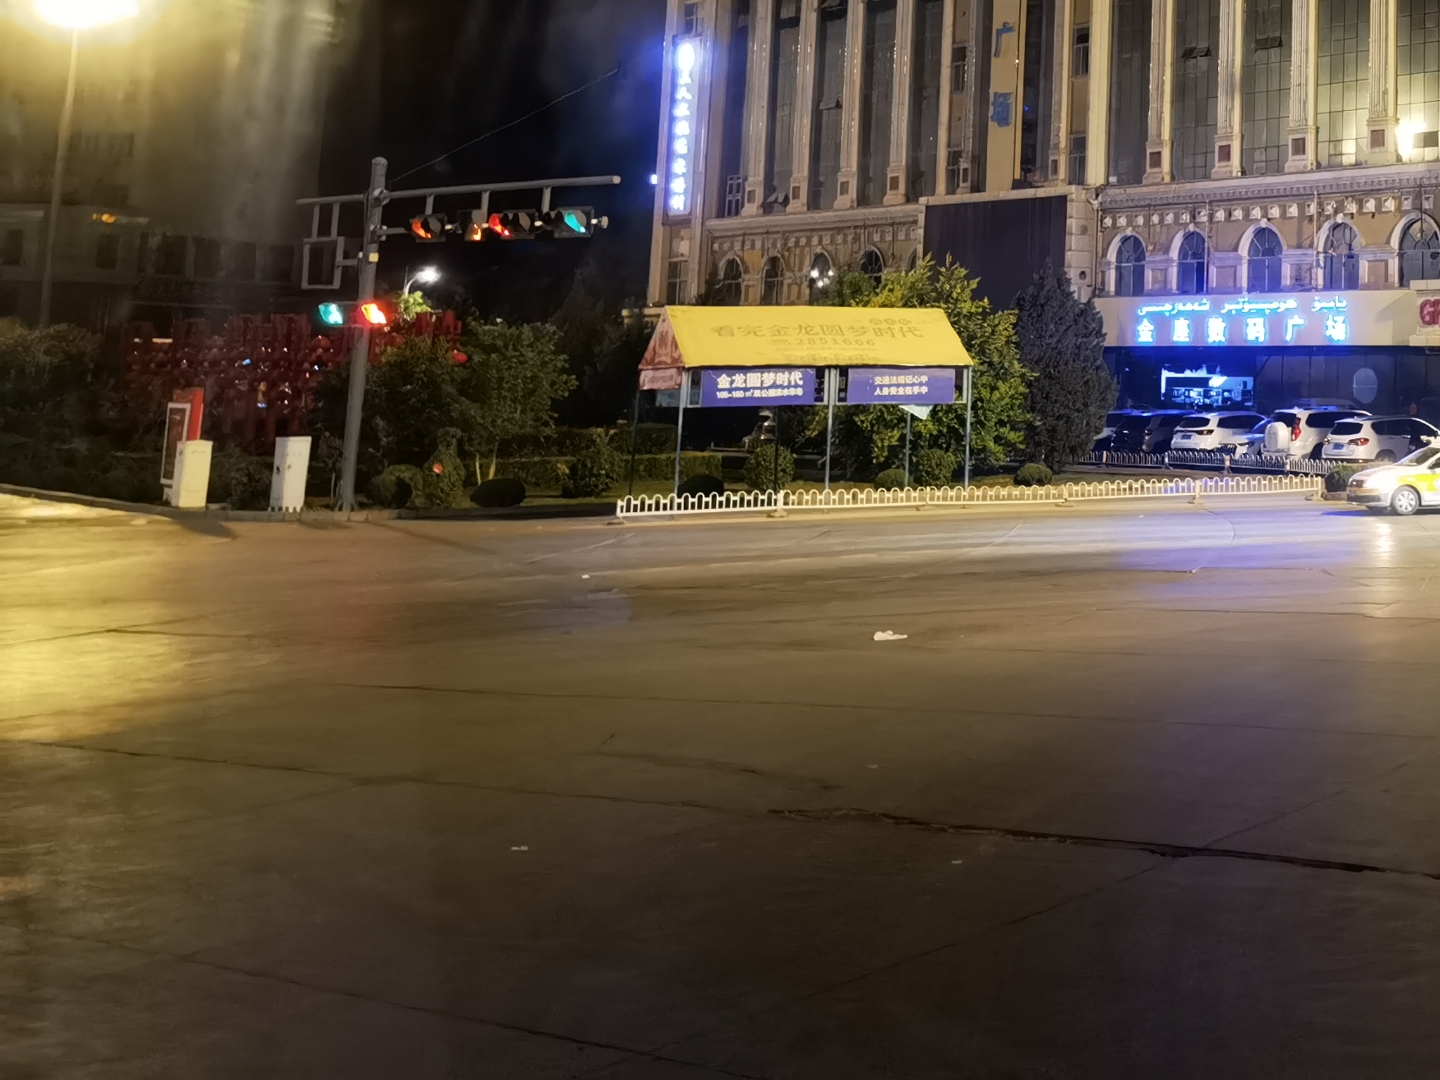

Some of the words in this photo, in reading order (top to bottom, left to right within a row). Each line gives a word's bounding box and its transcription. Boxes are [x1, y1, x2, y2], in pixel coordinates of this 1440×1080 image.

[717, 370, 803, 389] 金龙圆梦时代
